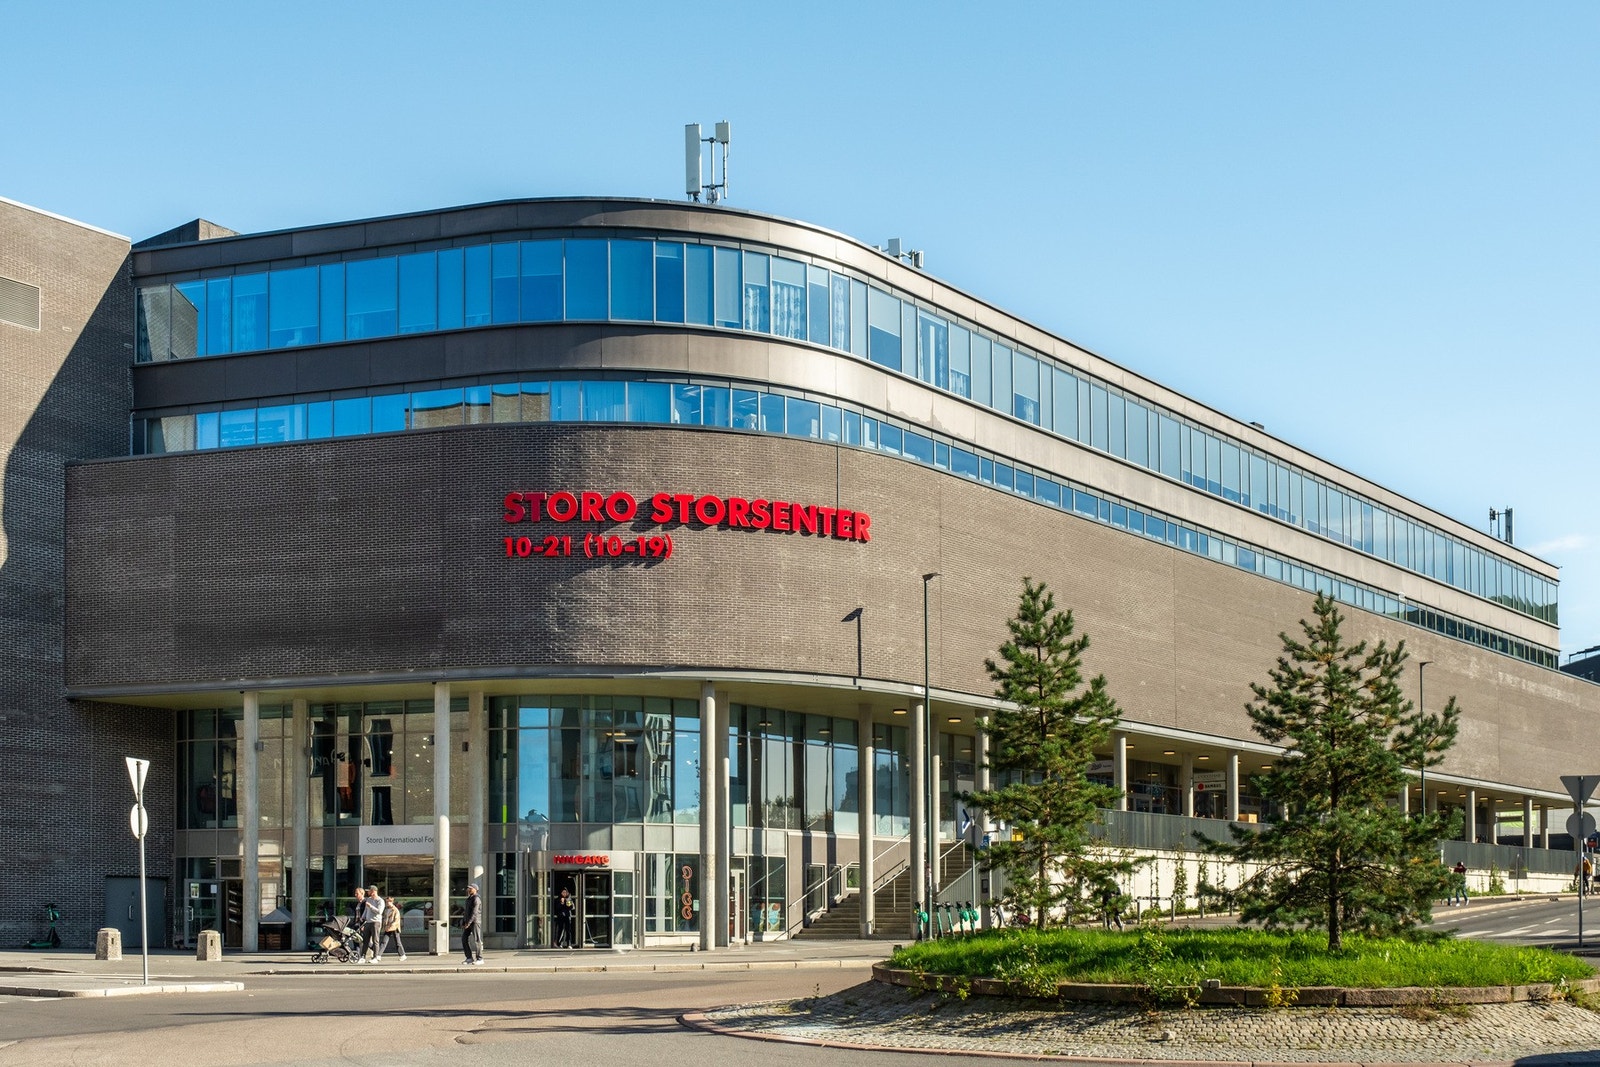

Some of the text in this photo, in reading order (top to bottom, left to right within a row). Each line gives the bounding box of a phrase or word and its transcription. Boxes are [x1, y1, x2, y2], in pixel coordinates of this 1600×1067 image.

[503, 491, 872, 542] STORO STORSENTER
[503, 533, 673, 559] 10-21 (10-19)
[366, 836, 382, 844] Storo
[383, 835, 424, 844] International
[553, 854, 610, 865] INNGANG
